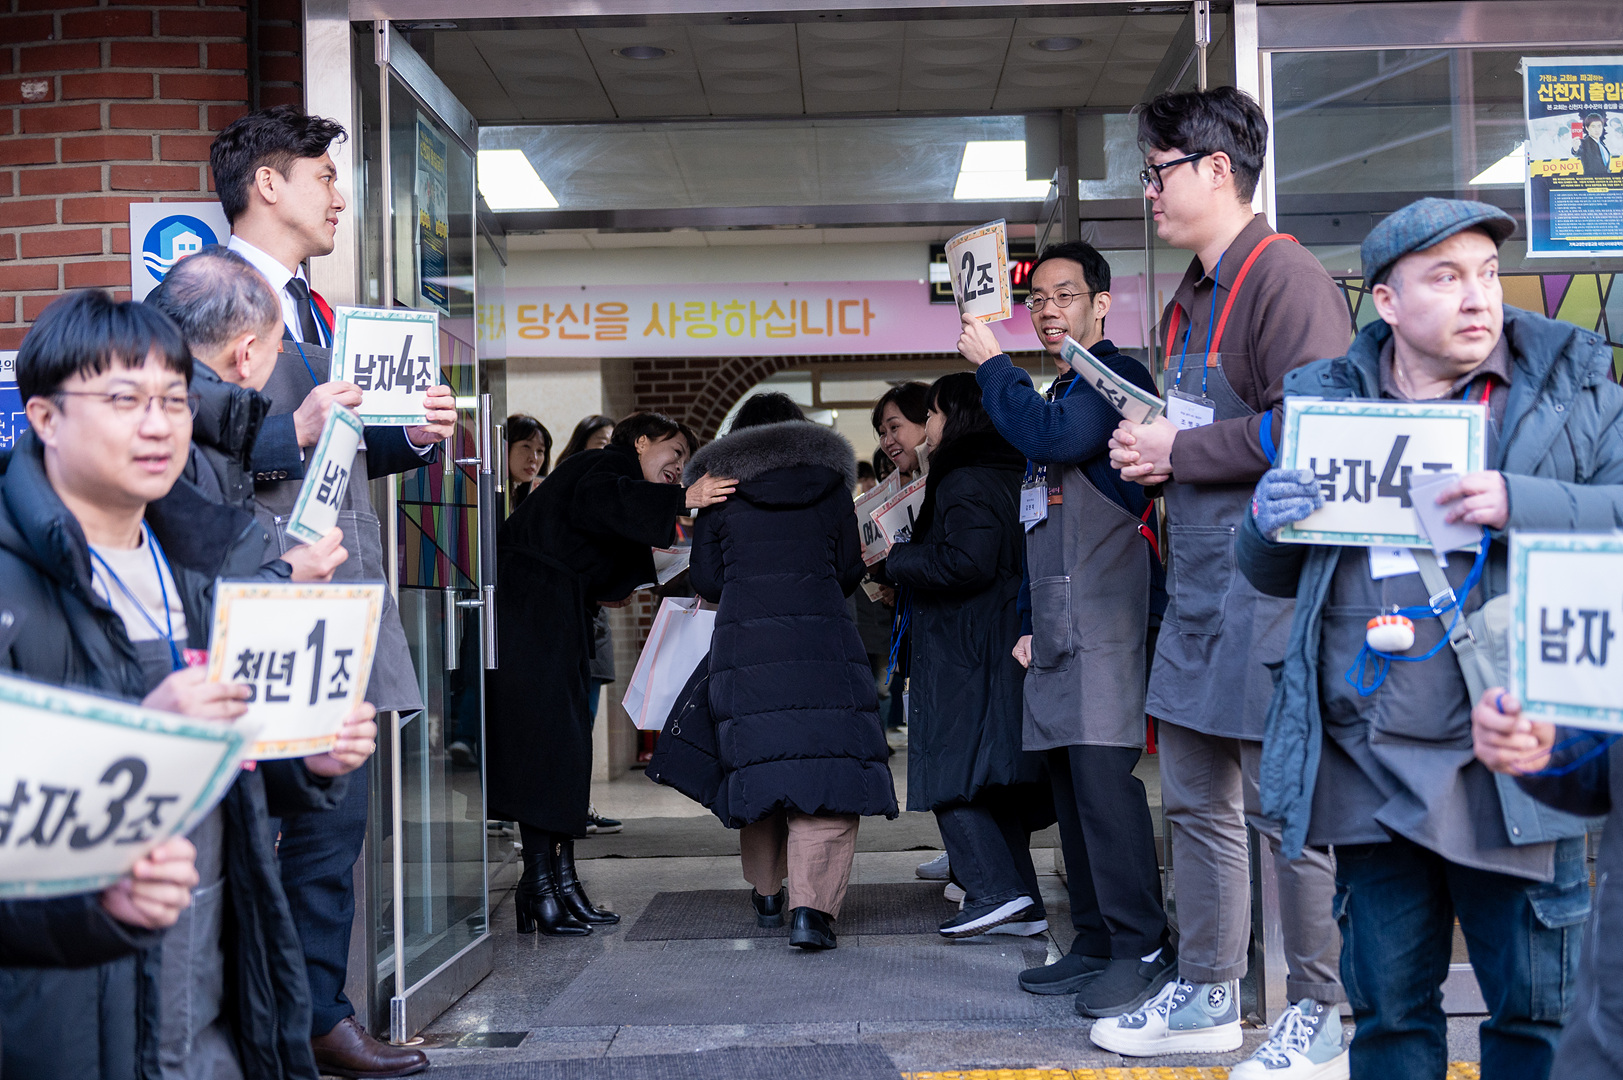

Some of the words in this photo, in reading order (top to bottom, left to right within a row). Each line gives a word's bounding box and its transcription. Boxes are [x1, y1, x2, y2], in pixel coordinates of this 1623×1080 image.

[1537, 83, 1585, 102] 신천지
[1589, 82, 1623, 101] 출입
[1543, 164, 1557, 172] DO
[1560, 163, 1580, 171] NOT
[516, 301, 629, 341] 당신을
[643, 298, 875, 340] 사랑하십니다
[354, 334, 432, 394] 남자4조
[1310, 434, 1453, 508] 남자4
